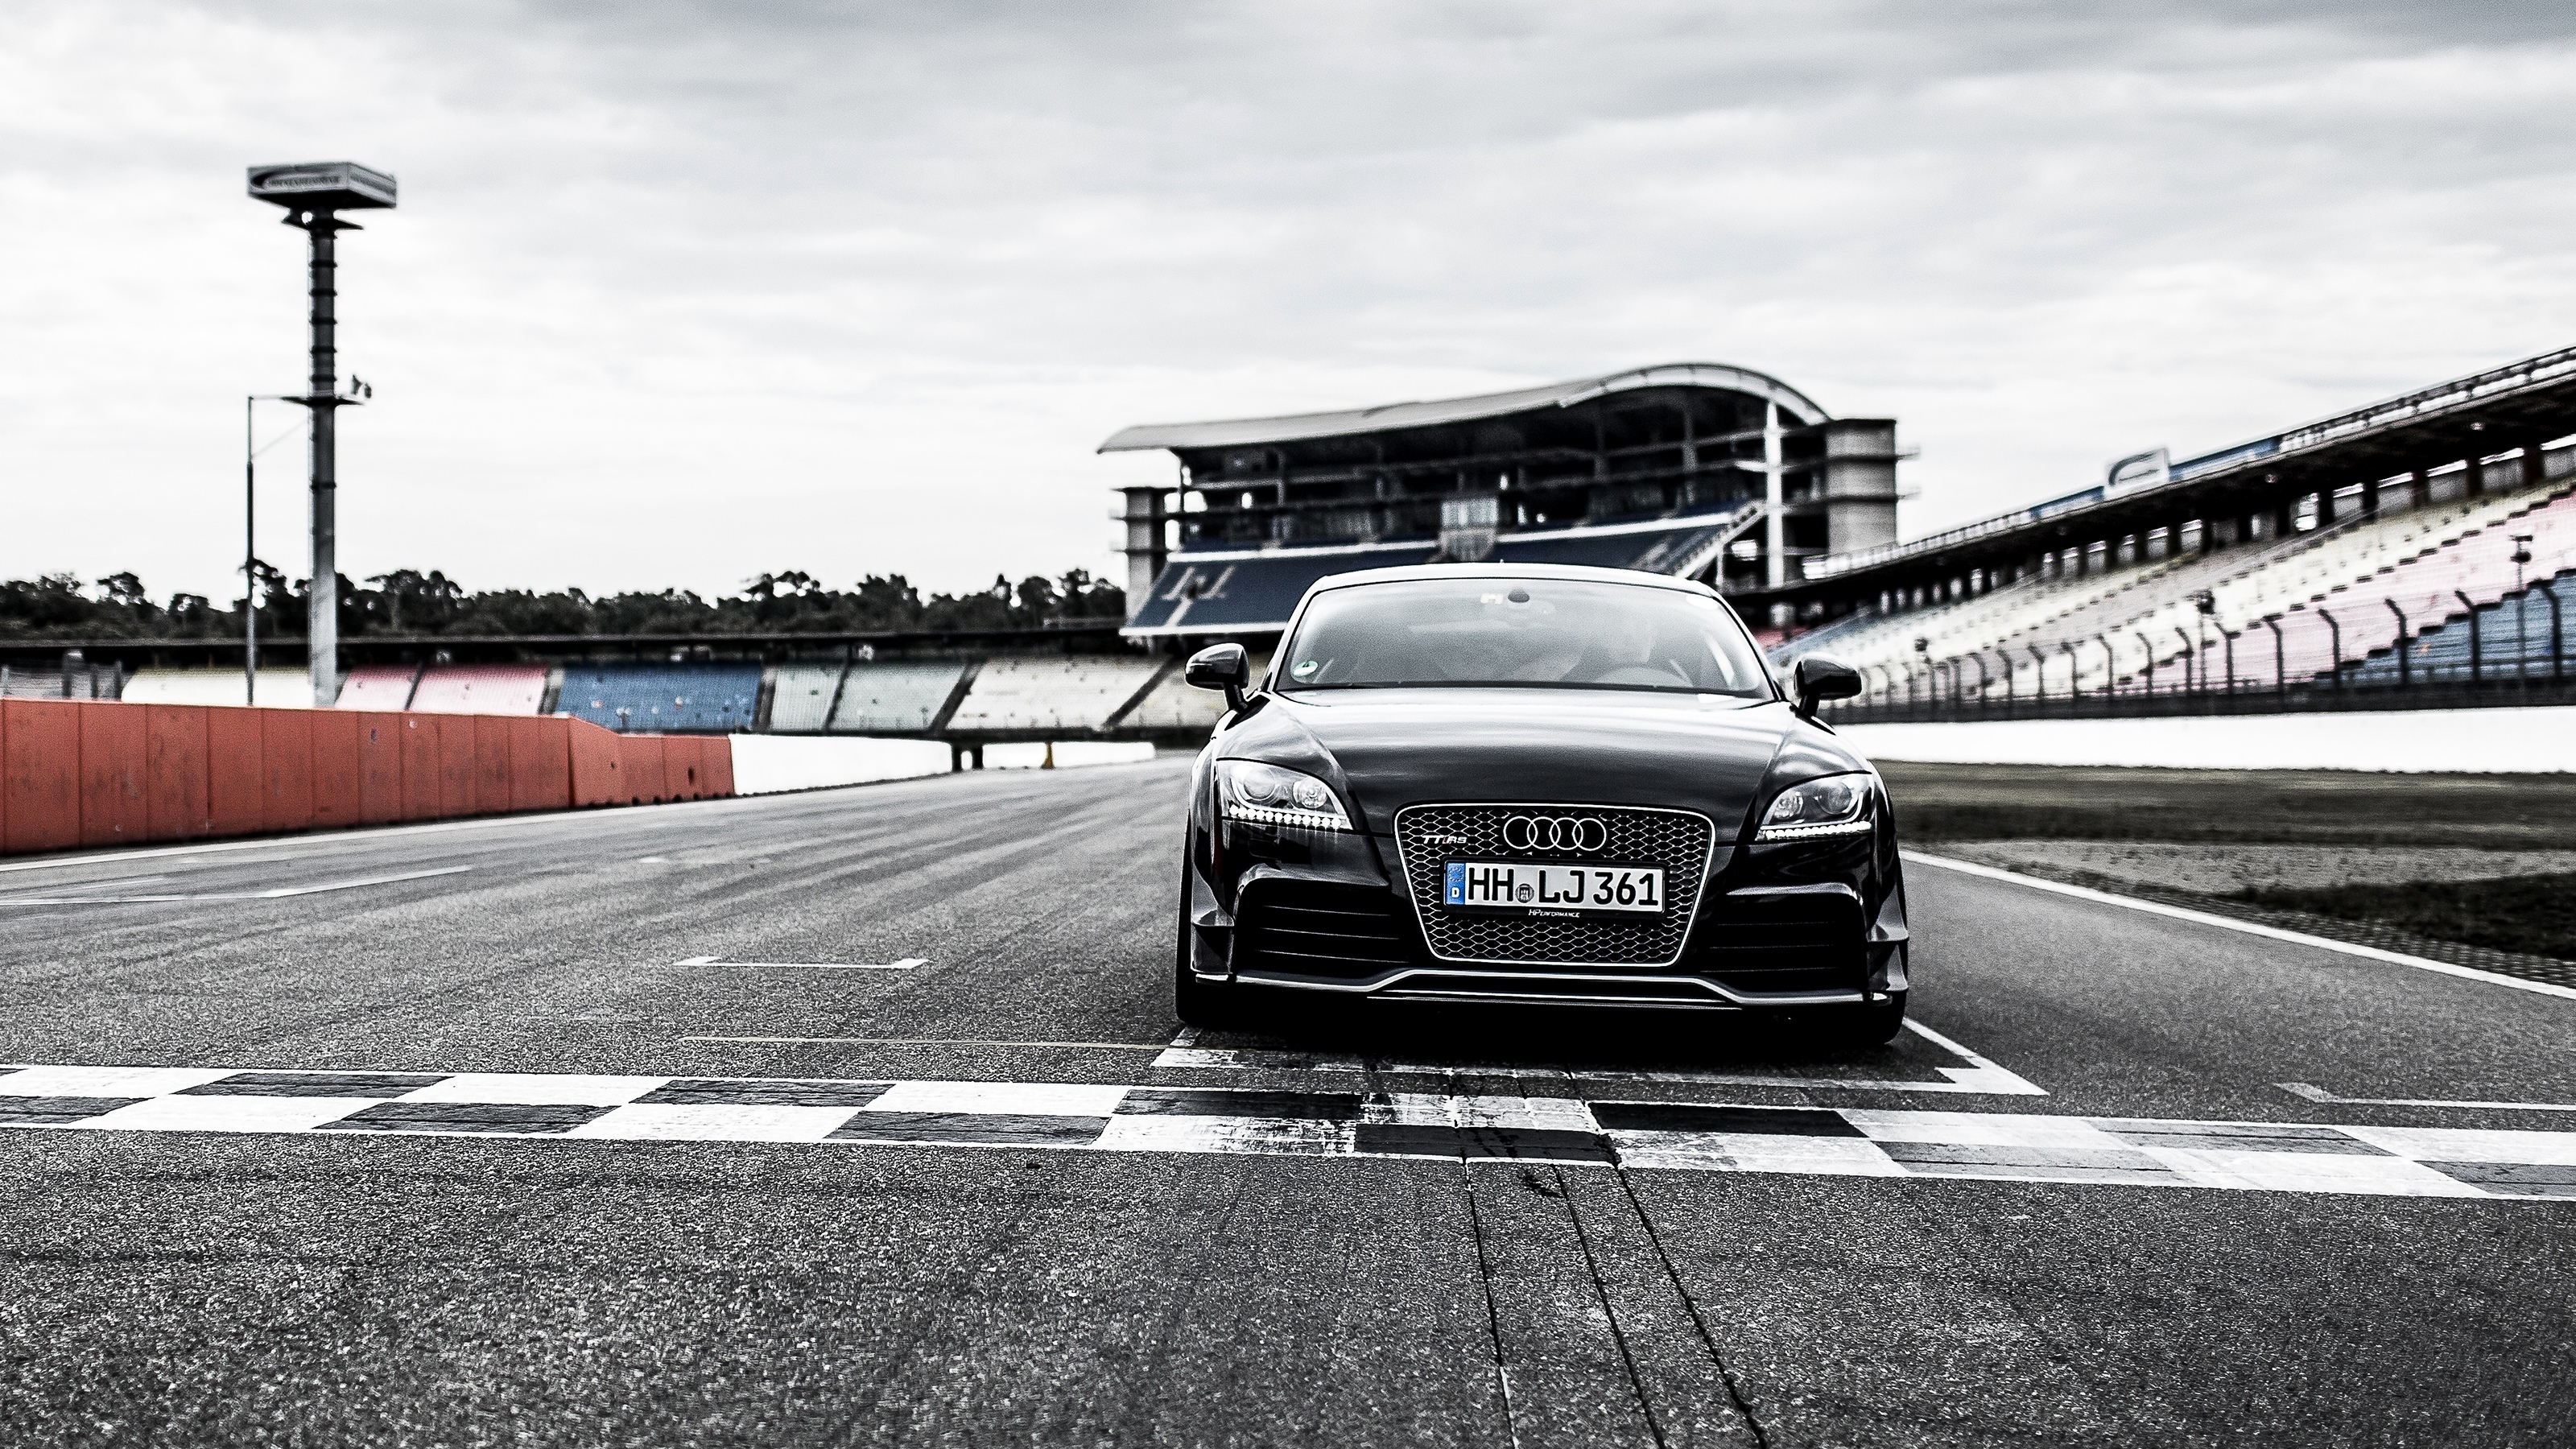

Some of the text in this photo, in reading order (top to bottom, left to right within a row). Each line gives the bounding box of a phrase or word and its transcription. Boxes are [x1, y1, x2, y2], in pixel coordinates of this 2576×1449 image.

[1451, 886, 1460, 898] D
[1468, 867, 1659, 906] HH LJ 361
